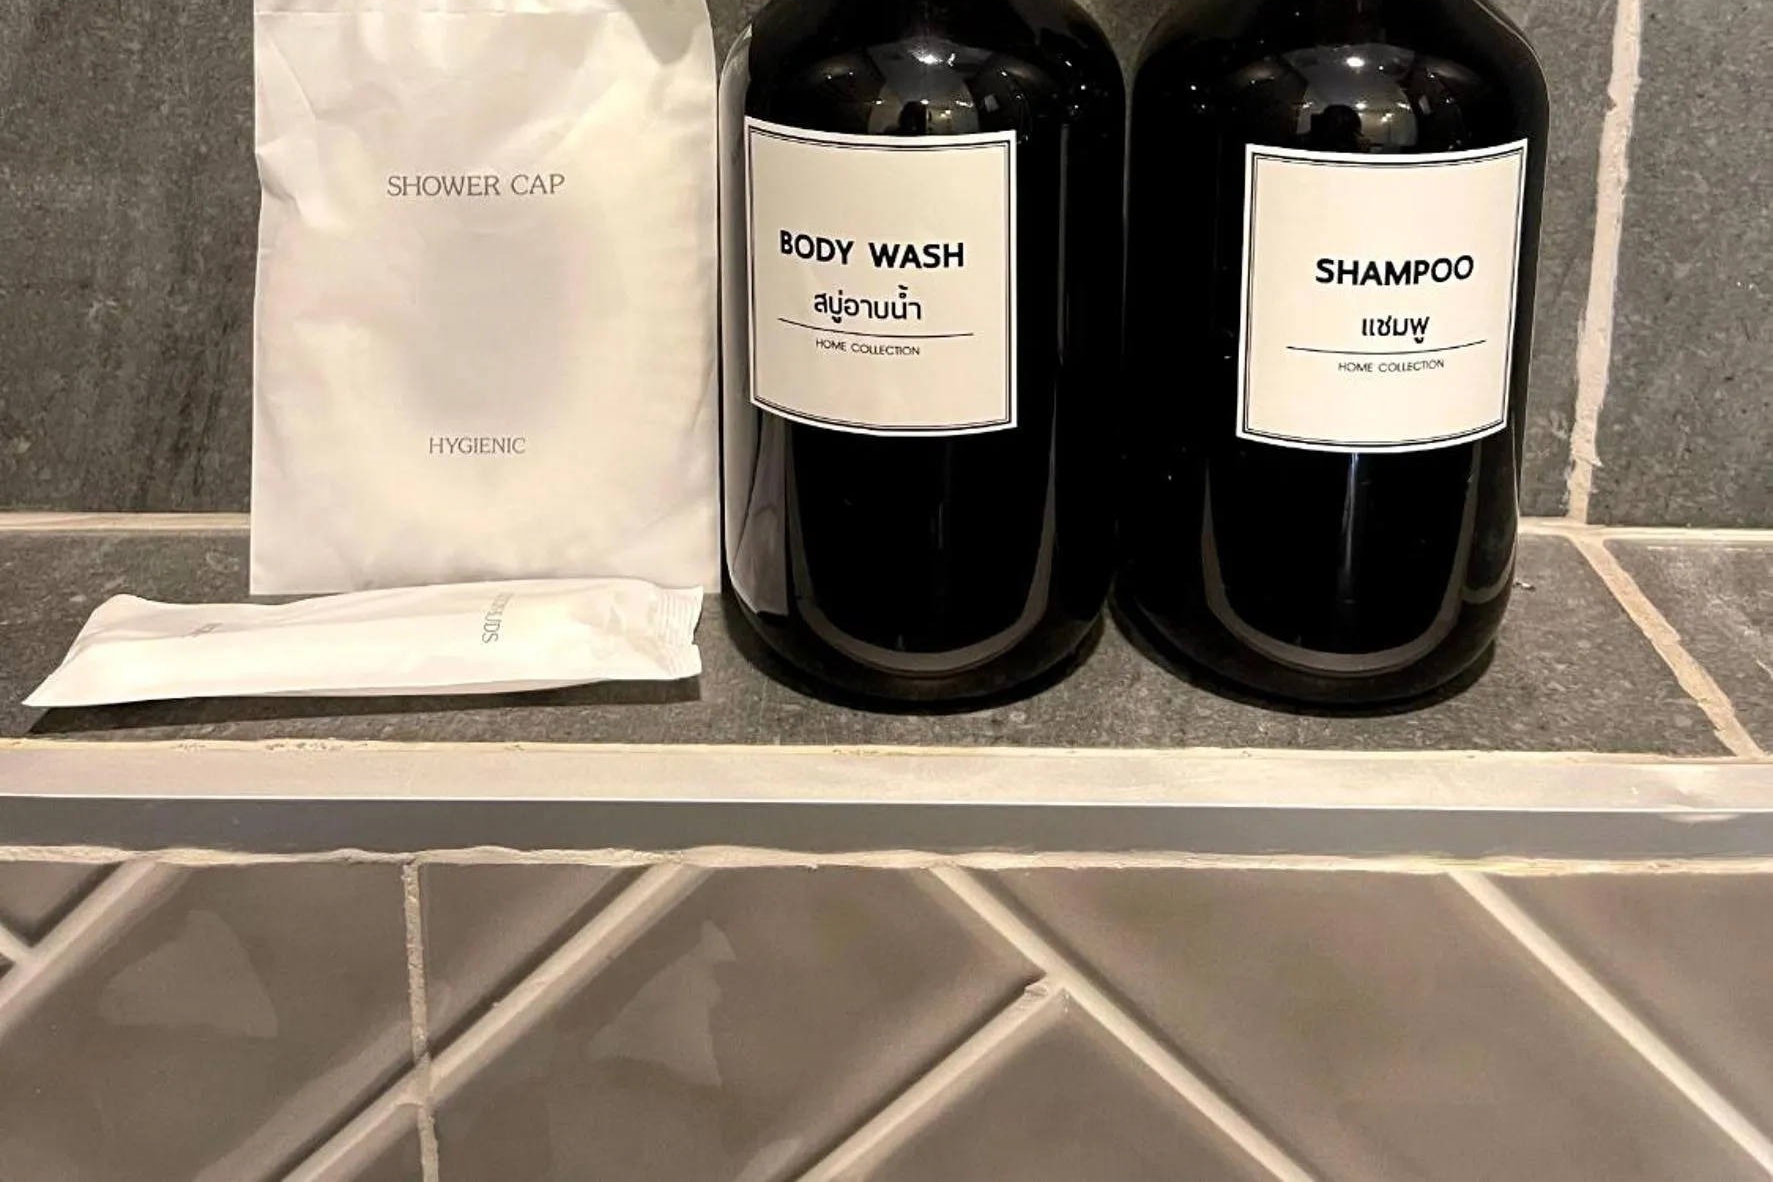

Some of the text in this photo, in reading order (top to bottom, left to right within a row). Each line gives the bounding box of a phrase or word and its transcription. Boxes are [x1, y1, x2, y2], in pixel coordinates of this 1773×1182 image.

[386, 173, 565, 197] SHOWER CAP
[779, 229, 965, 269] BODY WASH
[1315, 254, 1475, 286] SHAMPOO
[813, 284, 922, 324] สบู่อาบน้ำ
[1361, 315, 1431, 344] แชมพู
[815, 339, 921, 356] HOME COLLECTION
[1338, 358, 1445, 373] HOME COLLECTION
[428, 436, 526, 455] HYGIENIC
